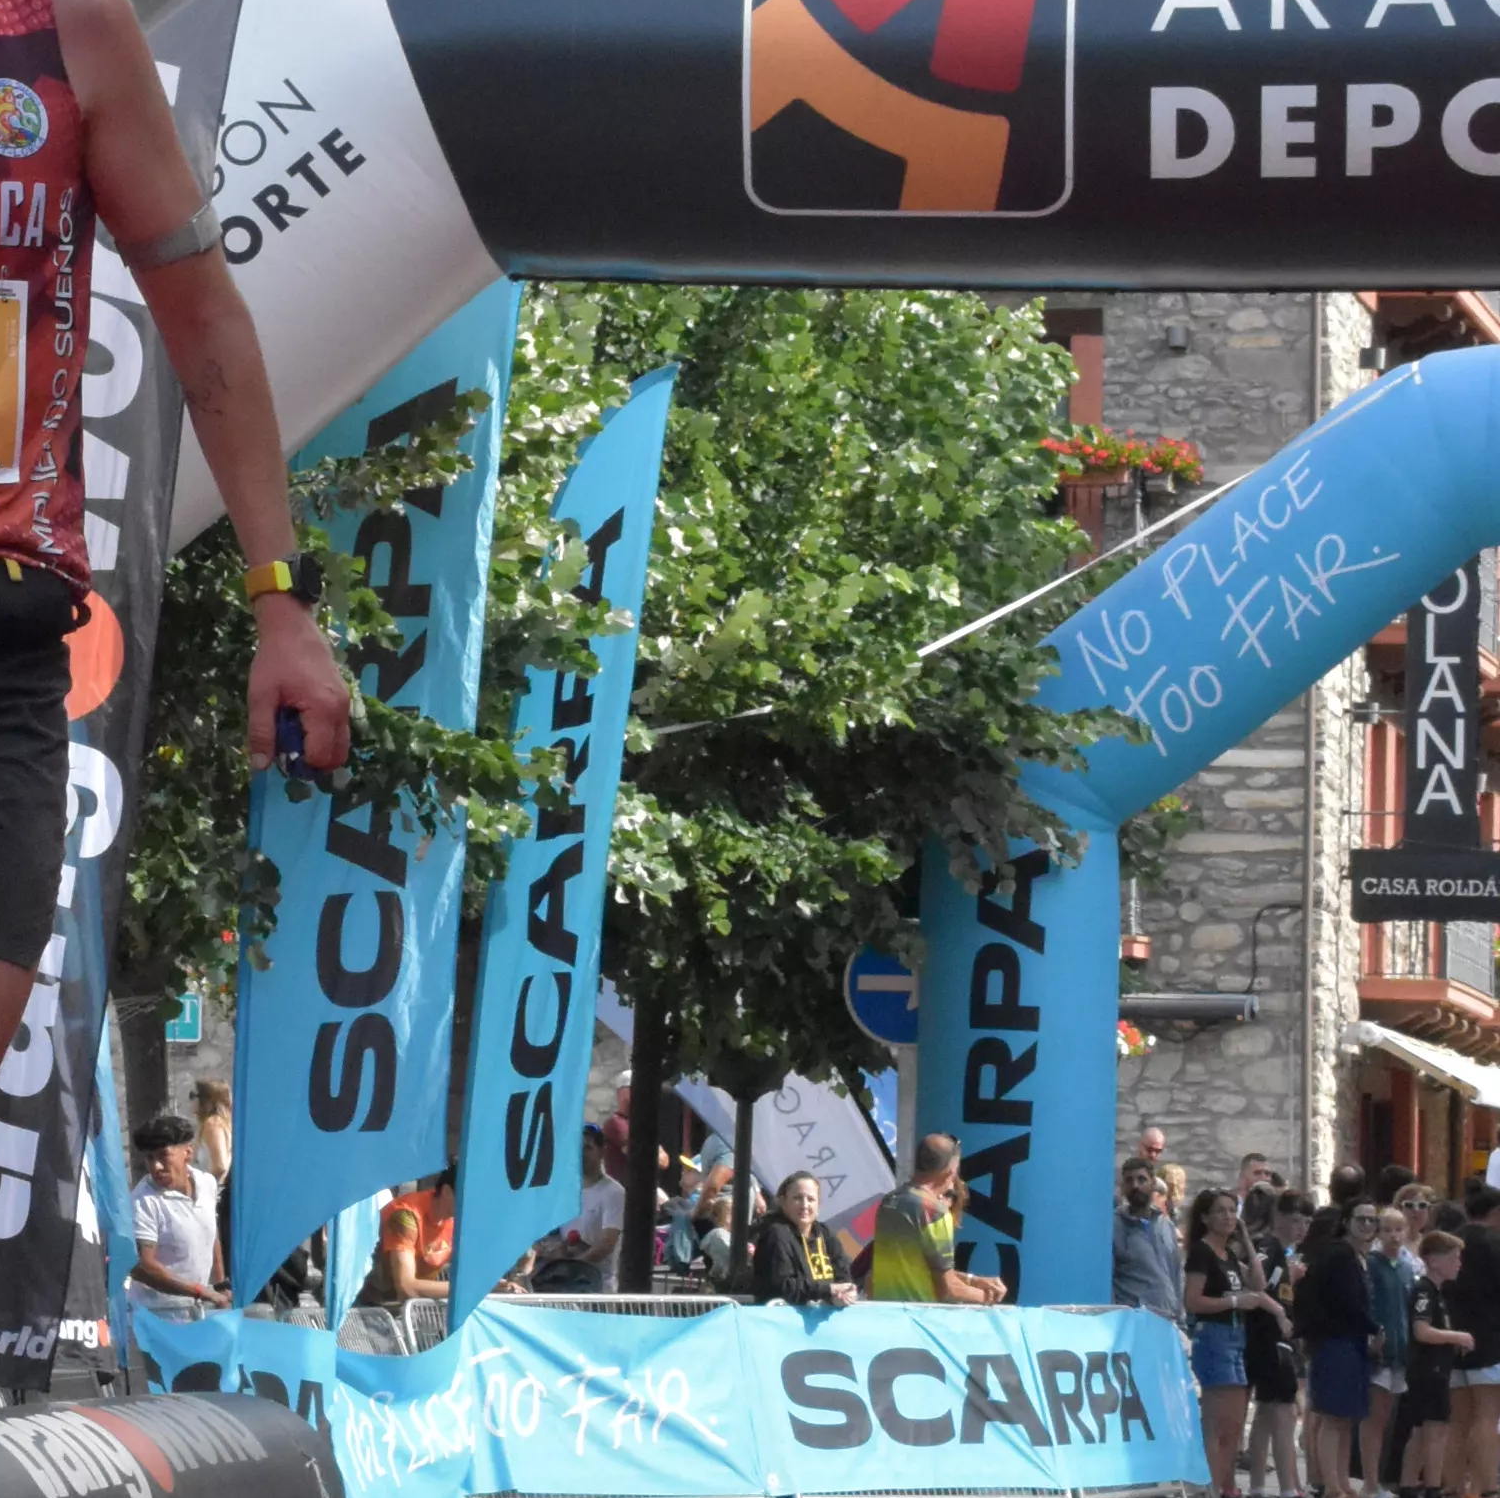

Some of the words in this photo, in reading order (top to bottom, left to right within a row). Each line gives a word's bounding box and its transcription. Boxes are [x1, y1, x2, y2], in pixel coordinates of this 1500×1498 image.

[221, 127, 366, 267] ORTE
[1150, 77, 1500, 180] DEPO
[52, 187, 75, 359] SUEÑOS
[1076, 606, 1153, 696] NO
[1160, 449, 1325, 620] PLACE
[1123, 664, 1224, 757] TOO
[1415, 567, 1468, 816] OLANA
[1361, 877, 1421, 897] CASA
[1424, 874, 1500, 898] ROLDÁ
[953, 848, 1051, 1305] CARPA
[779, 1347, 1156, 1451] SCARPA
